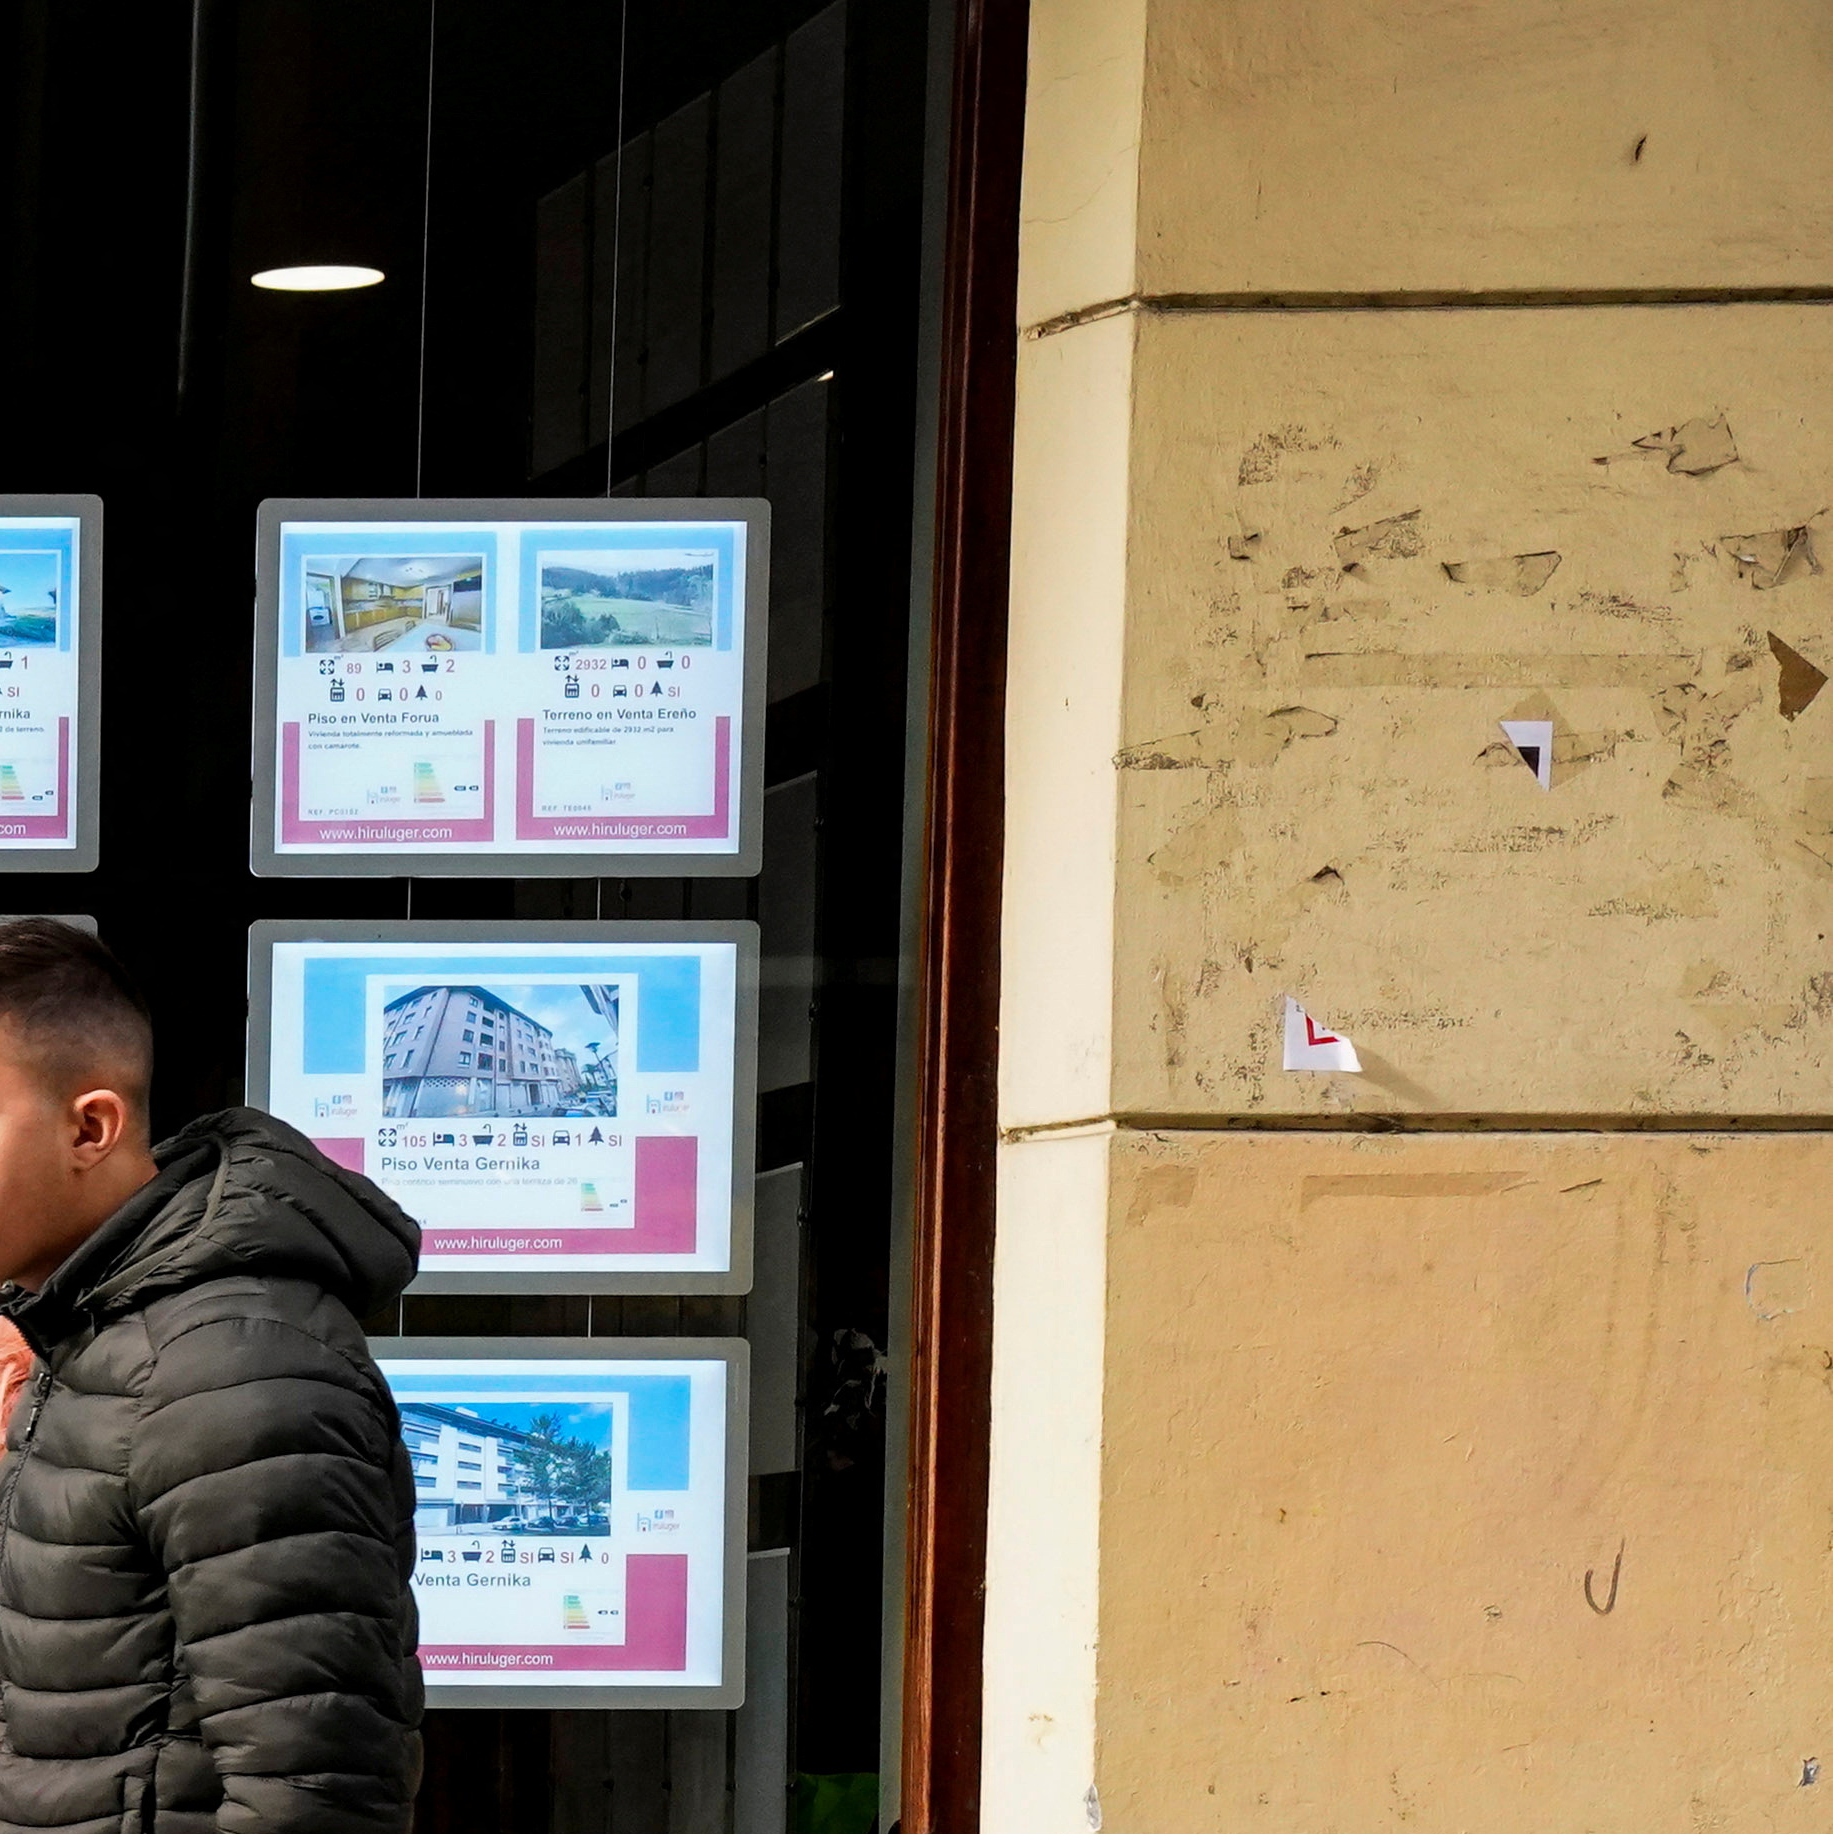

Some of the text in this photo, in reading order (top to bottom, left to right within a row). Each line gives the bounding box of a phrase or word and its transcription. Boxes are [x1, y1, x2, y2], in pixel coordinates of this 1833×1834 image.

[21, 656, 27, 669] 1
[347, 659, 454, 674] 89 3 2
[576, 656, 690, 670] 2932 0 0
[309, 713, 336, 724] Piso
[361, 713, 396, 723] Venta
[402, 712, 439, 723] Forua
[543, 708, 696, 720] Terreno en Venta Ereño
[317, 827, 454, 843] www.hiruluger.com
[554, 823, 689, 839] www.hiruluger.com
[382, 1157, 539, 1170] Piso Venta Gernika
[434, 1237, 562, 1251] www.hiruluger.com
[448, 1550, 609, 1564] 3 2 SI SI 0
[413, 1572, 530, 1586] Venta Gernika
[426, 1653, 553, 1667] www.hiruluger.com
